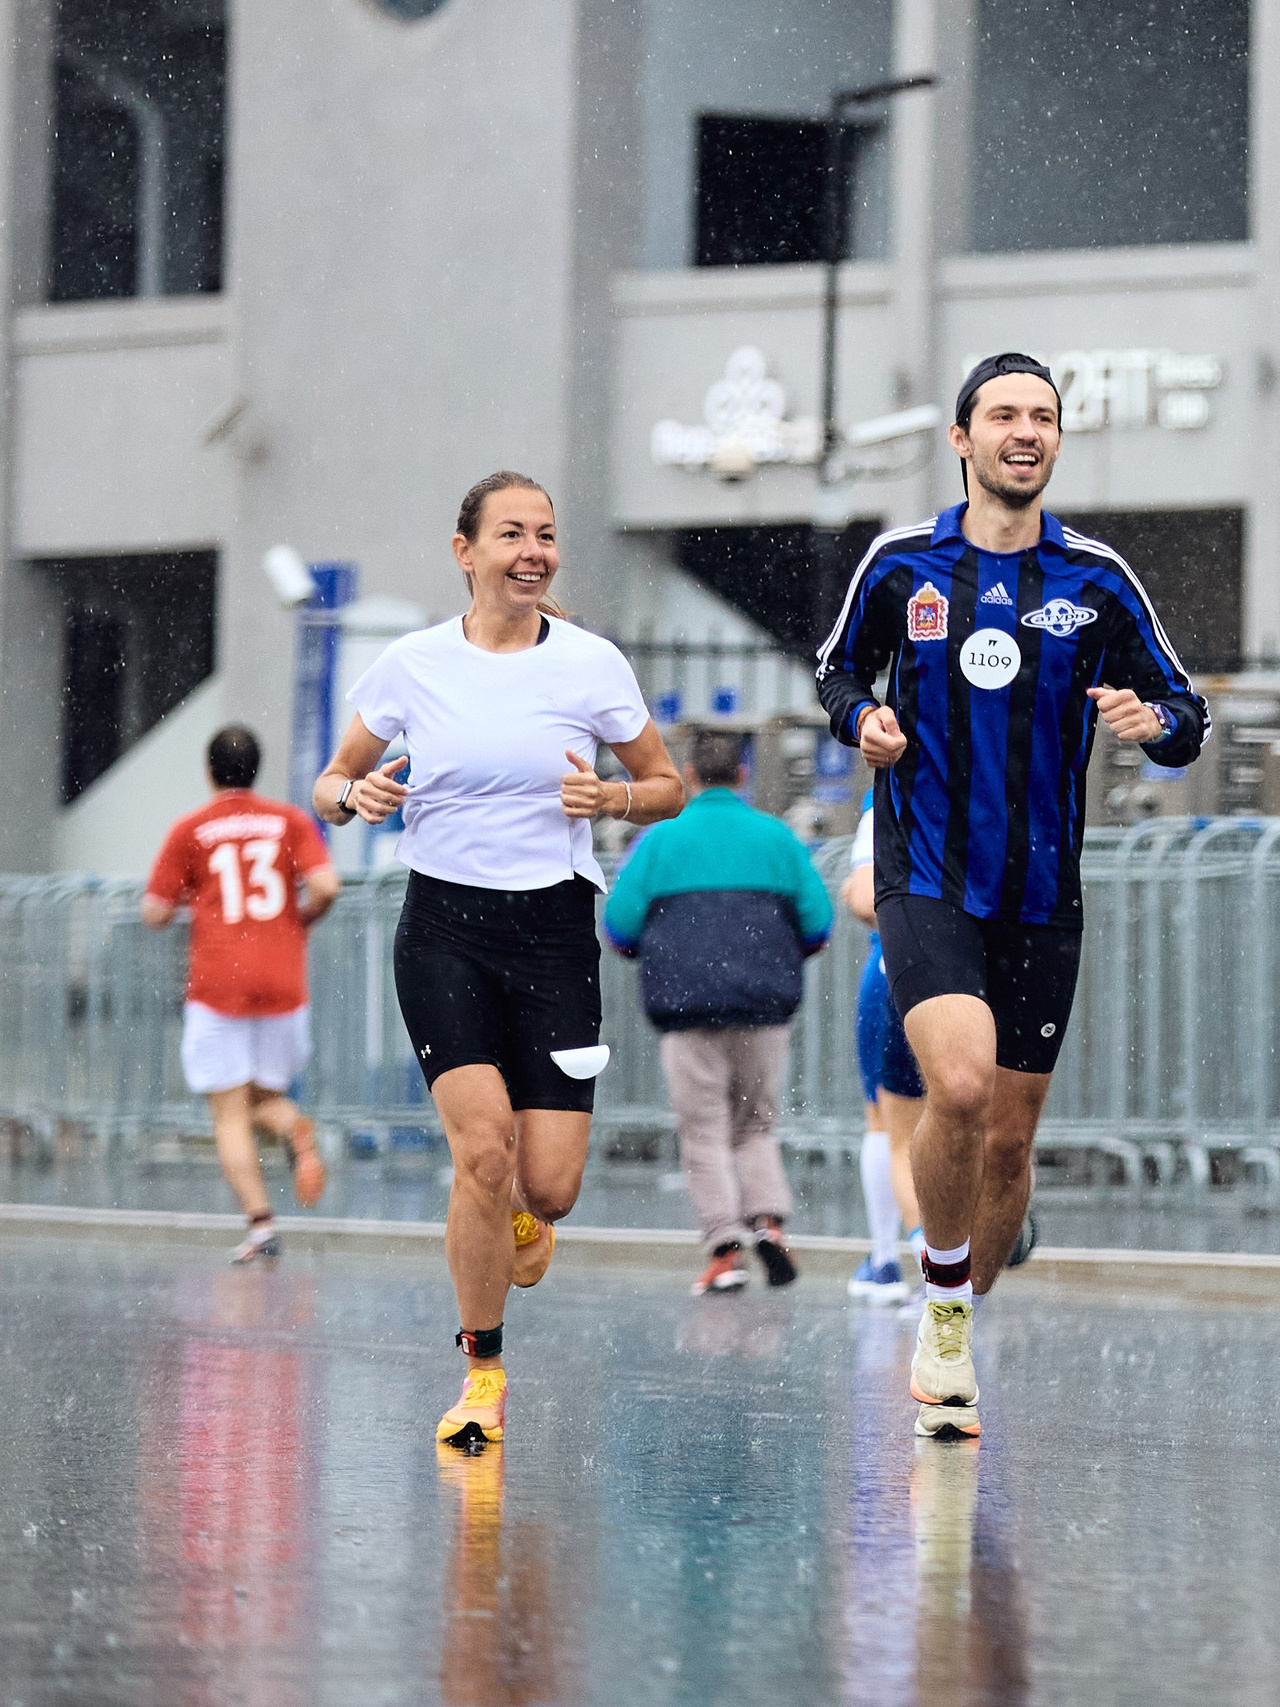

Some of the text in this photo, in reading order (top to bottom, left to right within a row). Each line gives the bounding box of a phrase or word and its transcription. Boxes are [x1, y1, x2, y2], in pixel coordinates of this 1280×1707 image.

[980, 595, 1013, 606] adidas
[968, 652, 1012, 670] 1109
[208, 841, 286, 924] 13
